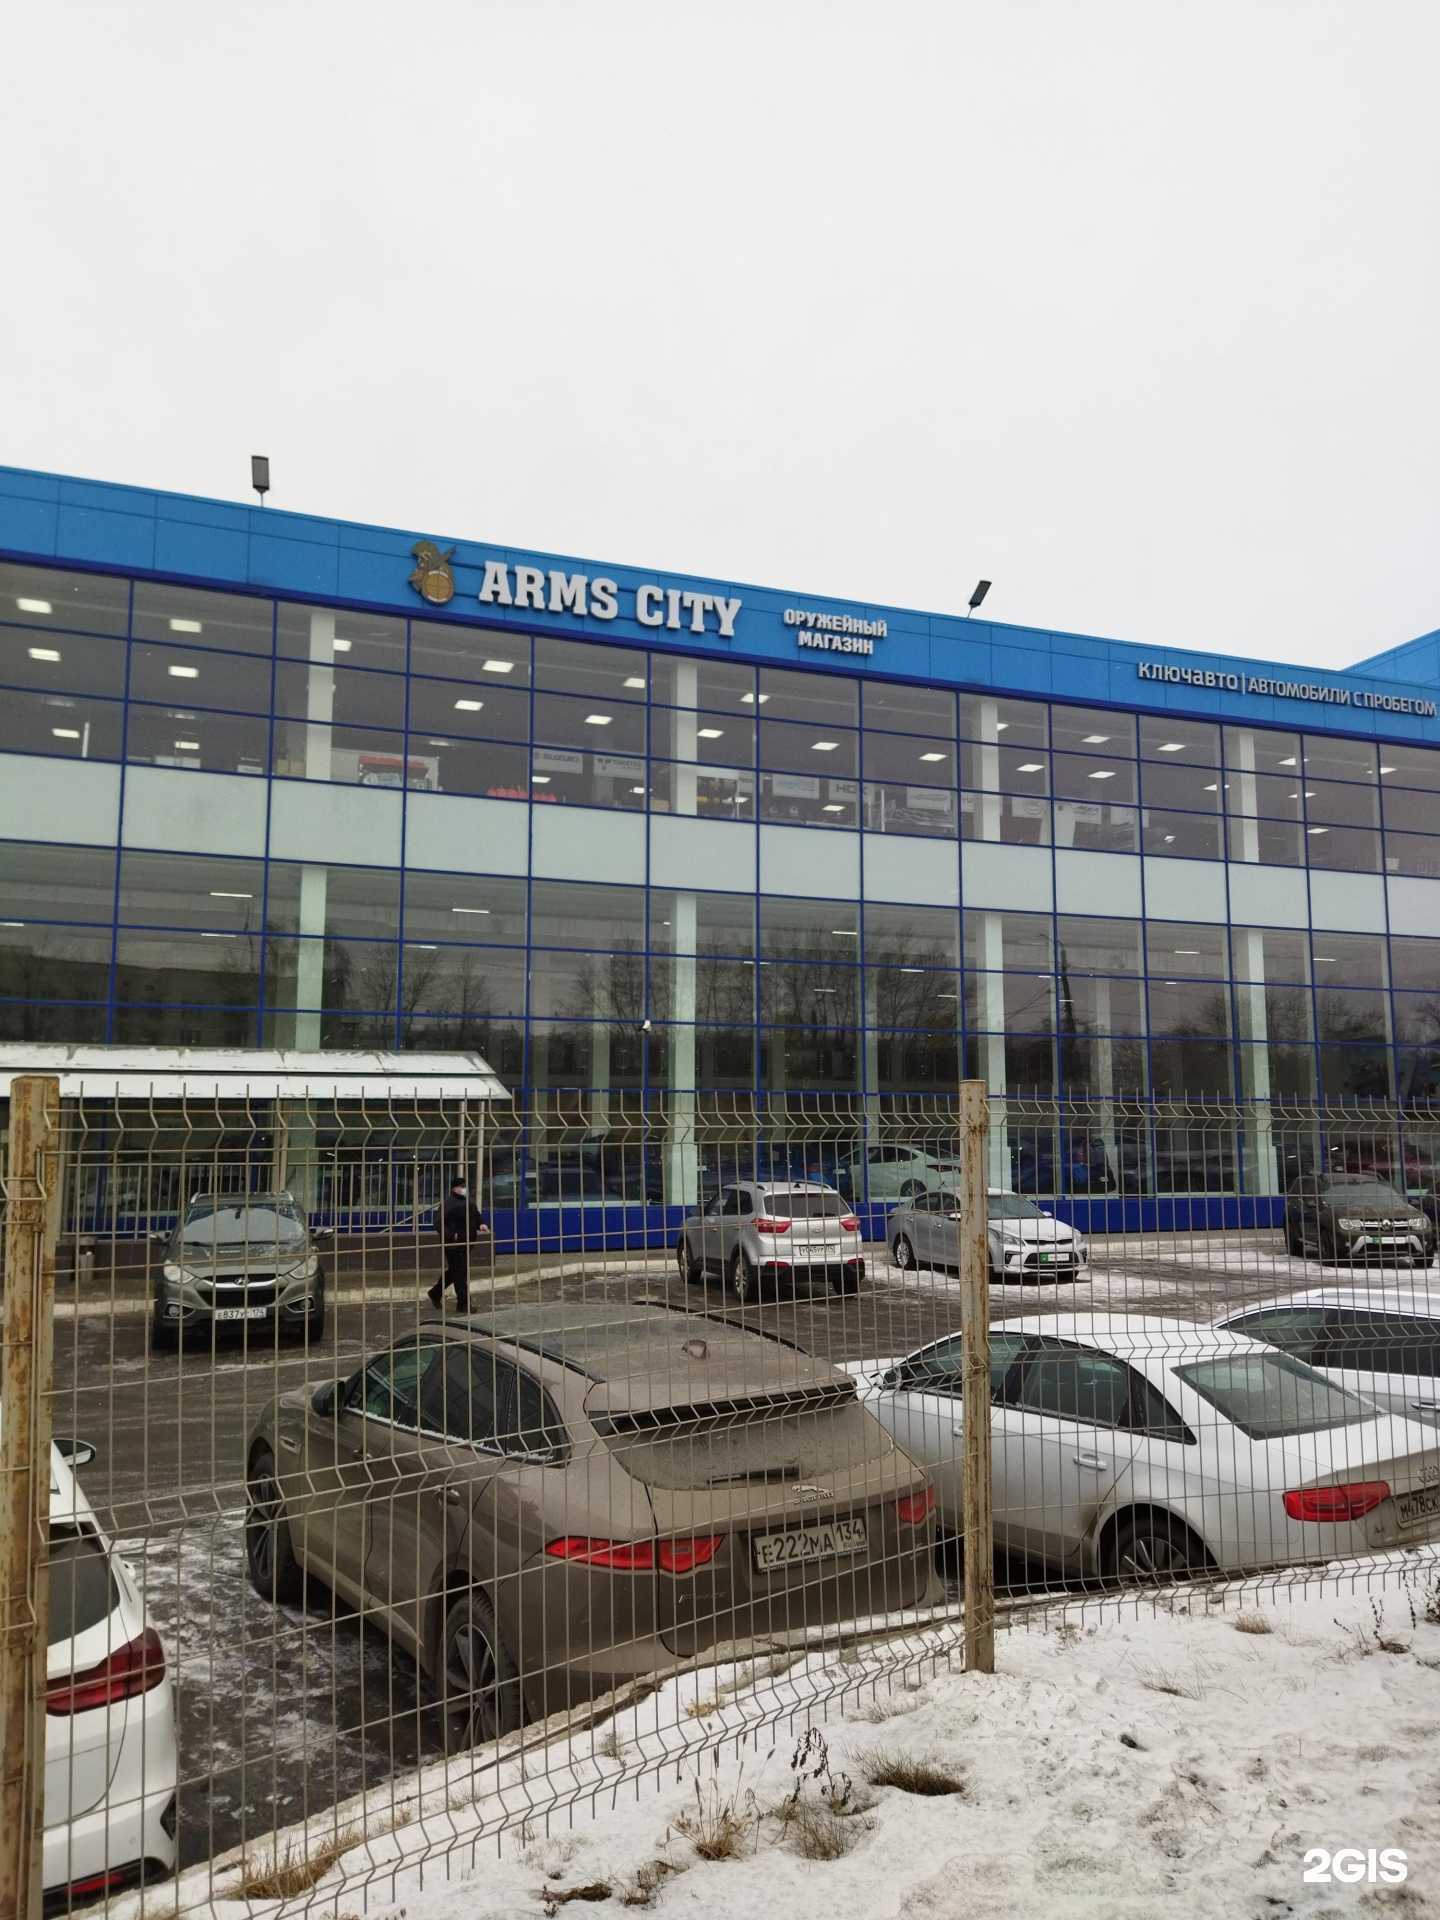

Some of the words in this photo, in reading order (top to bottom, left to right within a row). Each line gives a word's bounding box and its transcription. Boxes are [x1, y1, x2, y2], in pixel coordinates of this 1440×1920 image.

[479, 561, 619, 620] ARMS
[635, 584, 742, 637] CITY
[783, 608, 888, 638] ОРУЖЕЙНЫЙ
[798, 630, 875, 656] МАГАЗИН
[1248, 677, 1351, 706] АВТОМОБИЛИ
[1353, 693, 1363, 707] С
[1364, 695, 1438, 718] ПРОБЕГОМ
